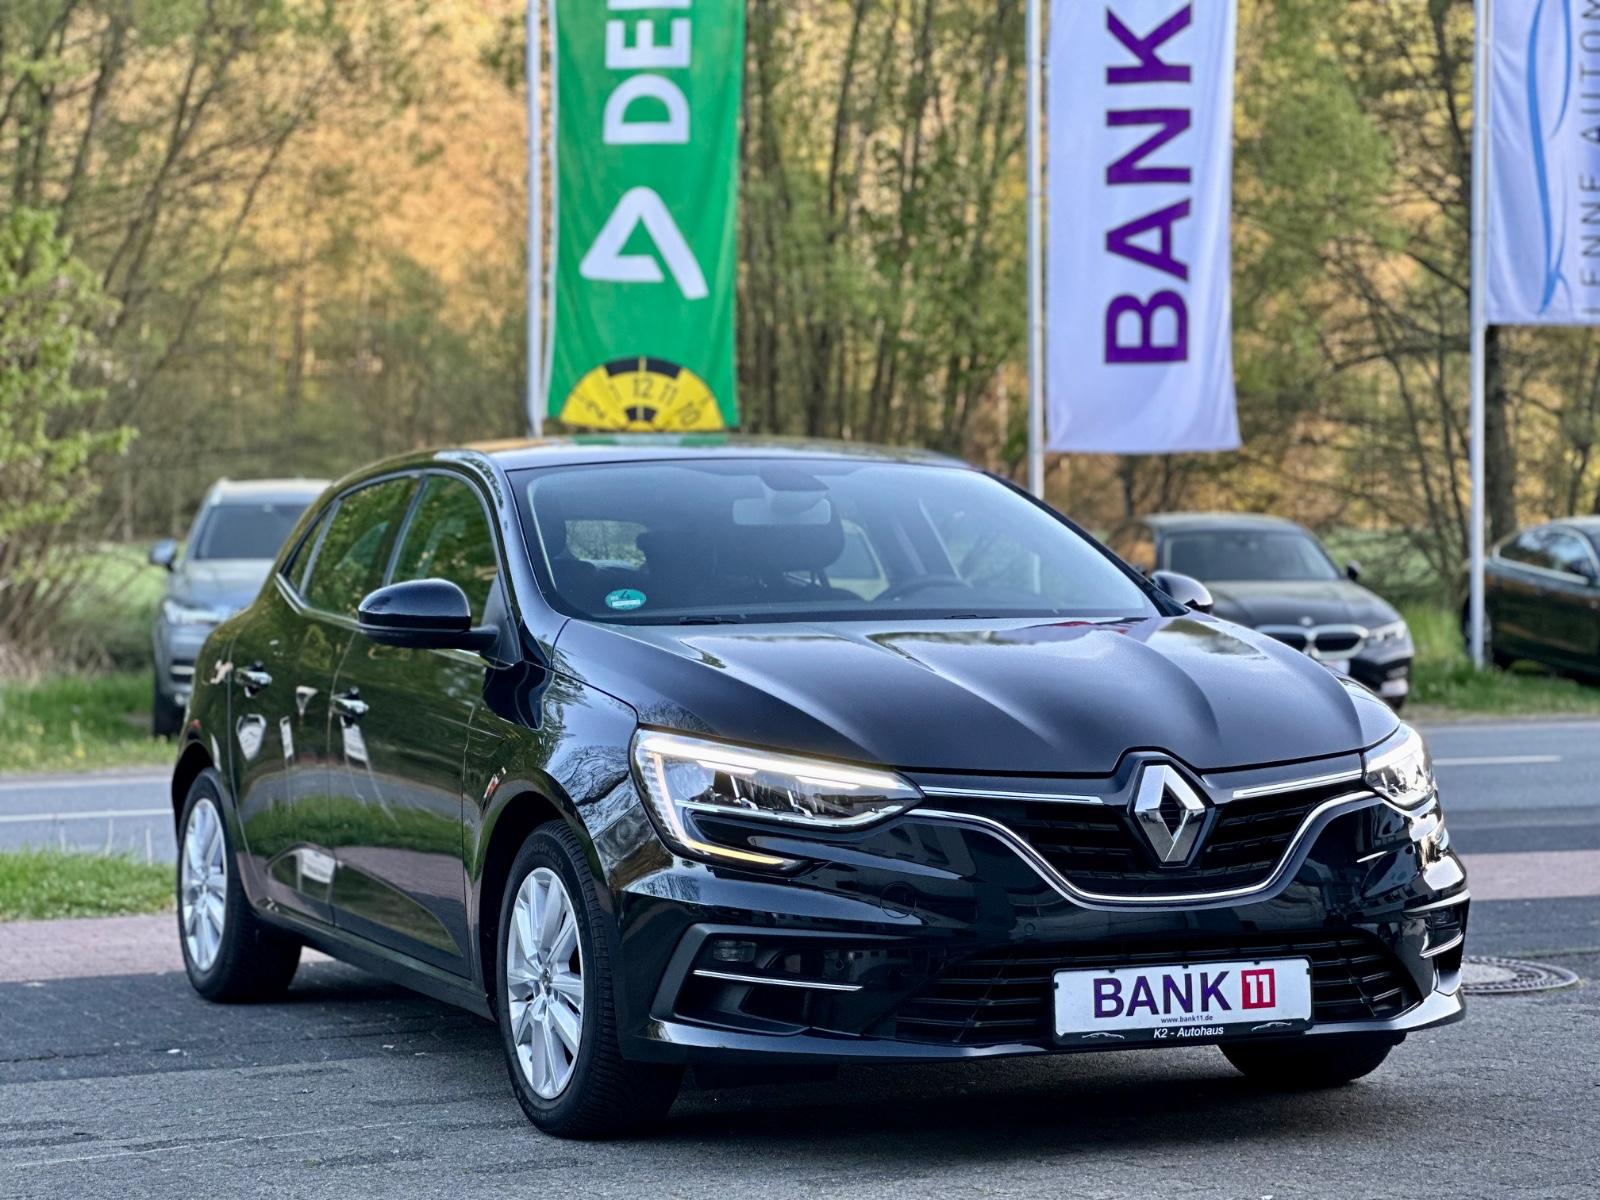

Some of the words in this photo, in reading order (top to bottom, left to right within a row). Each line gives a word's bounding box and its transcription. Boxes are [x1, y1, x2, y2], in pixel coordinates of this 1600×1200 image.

[603, 0, 692, 144] DE
[1104, 2, 1192, 365] BANK
[632, 377, 655, 399] 12
[1093, 970, 1232, 1018] BANK
[1244, 972, 1273, 1006] 11
[1153, 1028, 1168, 1039] K2
[1176, 1025, 1224, 1038] Autohaus
[1160, 1014, 1214, 1025] www.bank11.de
